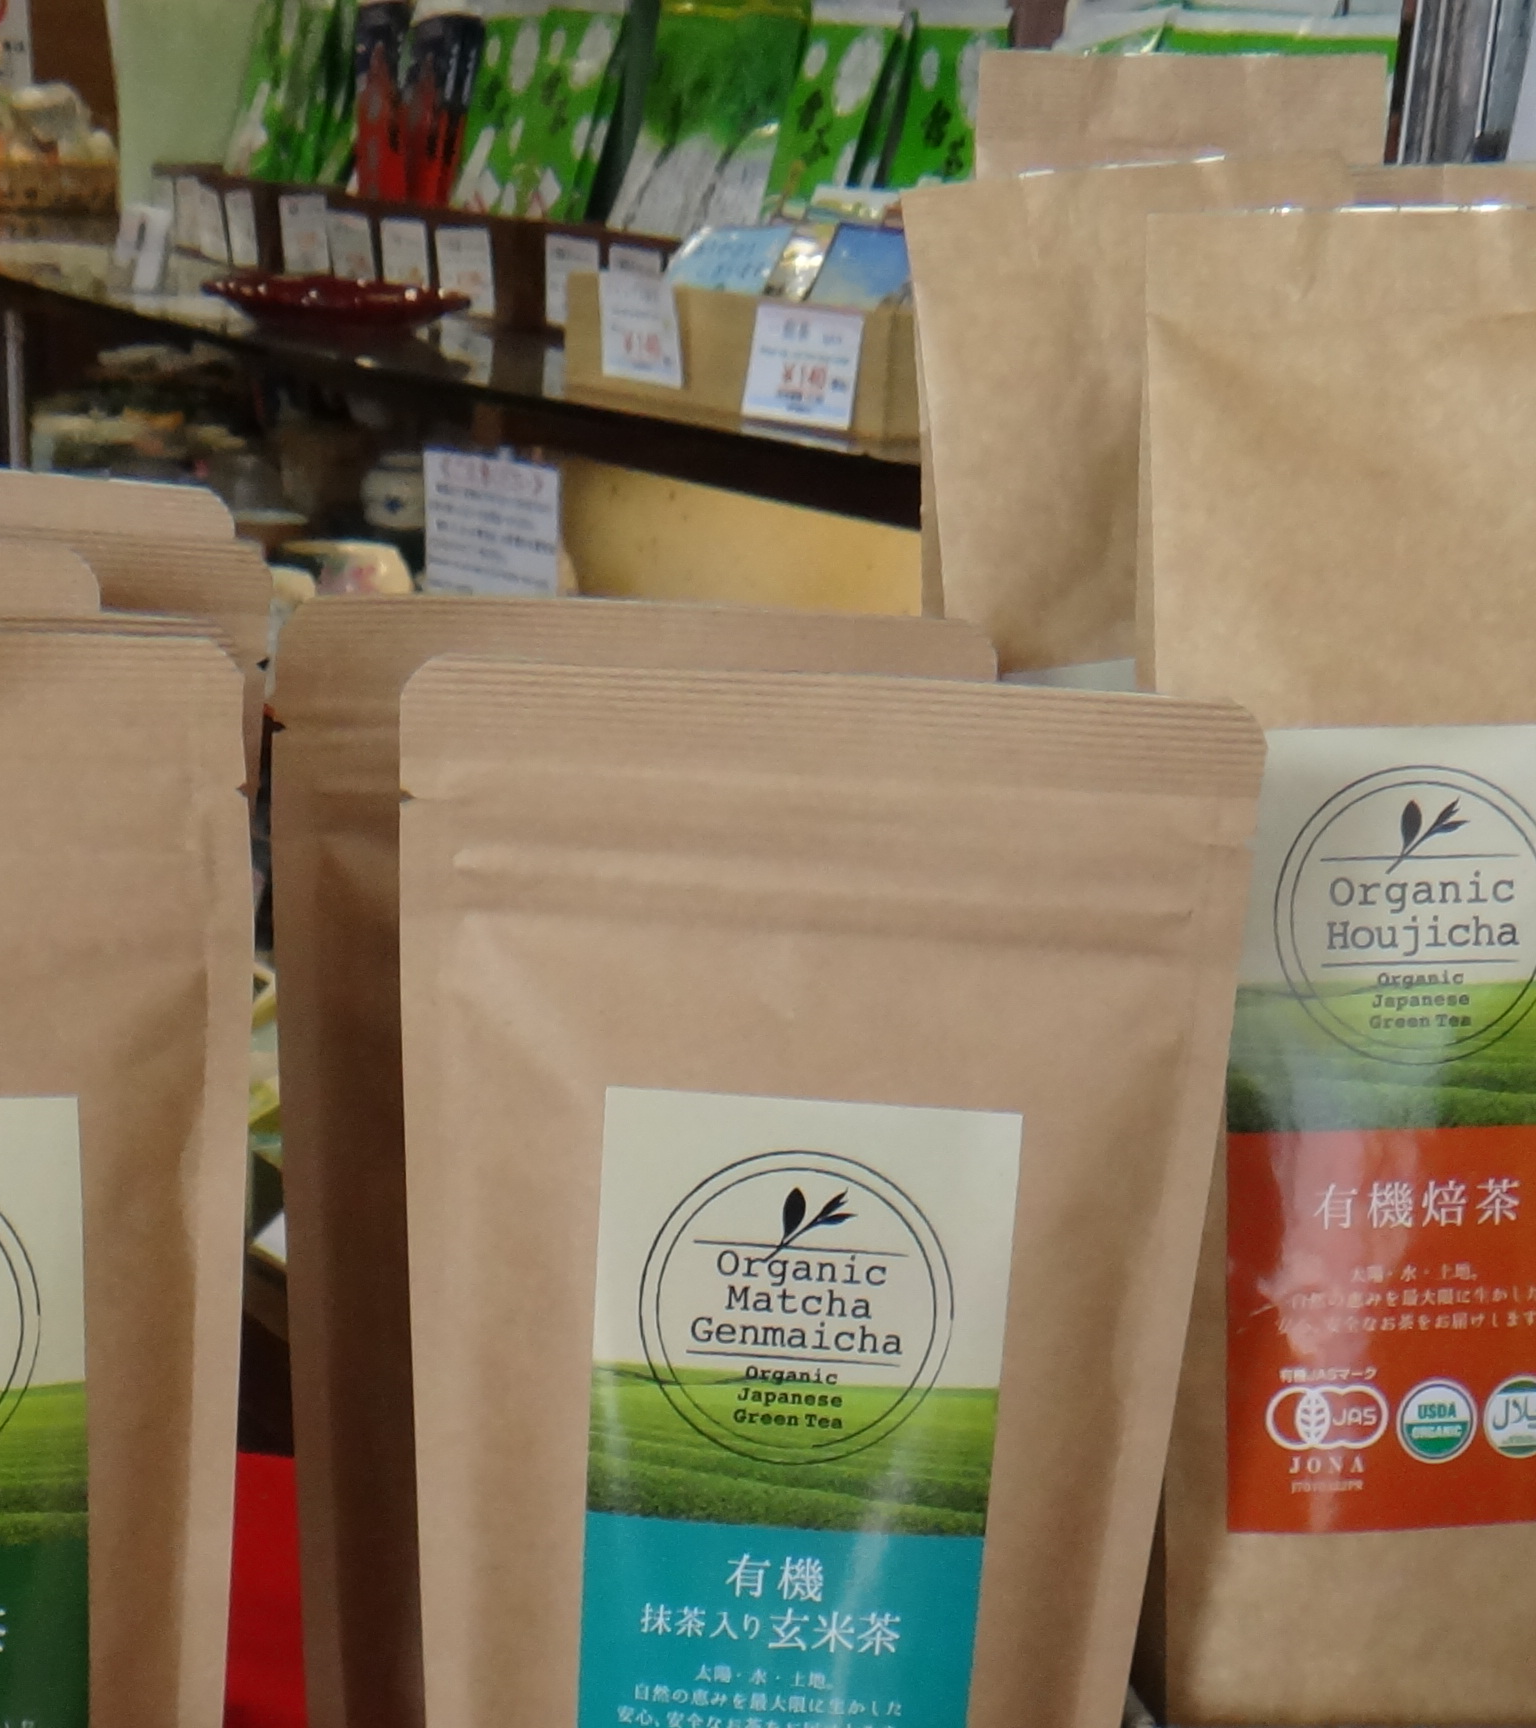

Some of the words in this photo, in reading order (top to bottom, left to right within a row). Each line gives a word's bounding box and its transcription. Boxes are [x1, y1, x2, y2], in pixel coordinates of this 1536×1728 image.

[1328, 870, 1514, 913] Organic
[1325, 914, 1520, 957] Houjicha
[1377, 971, 1465, 990] Organic
[1372, 991, 1471, 1010] Japanese
[1369, 1013, 1431, 1031] Green
[1435, 1012, 1472, 1028] Tea
[1314, 1178, 1521, 1231] 有機焙茶
[717, 1250, 887, 1287] Organic
[725, 1285, 872, 1319] Matcha
[691, 1316, 903, 1355] Genmaicha
[745, 1365, 838, 1385] Organic
[737, 1387, 843, 1407] Japanese
[733, 1409, 799, 1427] Green
[804, 1413, 843, 1429] Tea
[1332, 1407, 1377, 1427] JAS
[1417, 1403, 1456, 1419] USDA
[1288, 1455, 1364, 1474] JONA
[726, 1553, 824, 1602] 有機
[640, 1603, 901, 1655] 抹茶入り玄米茶
